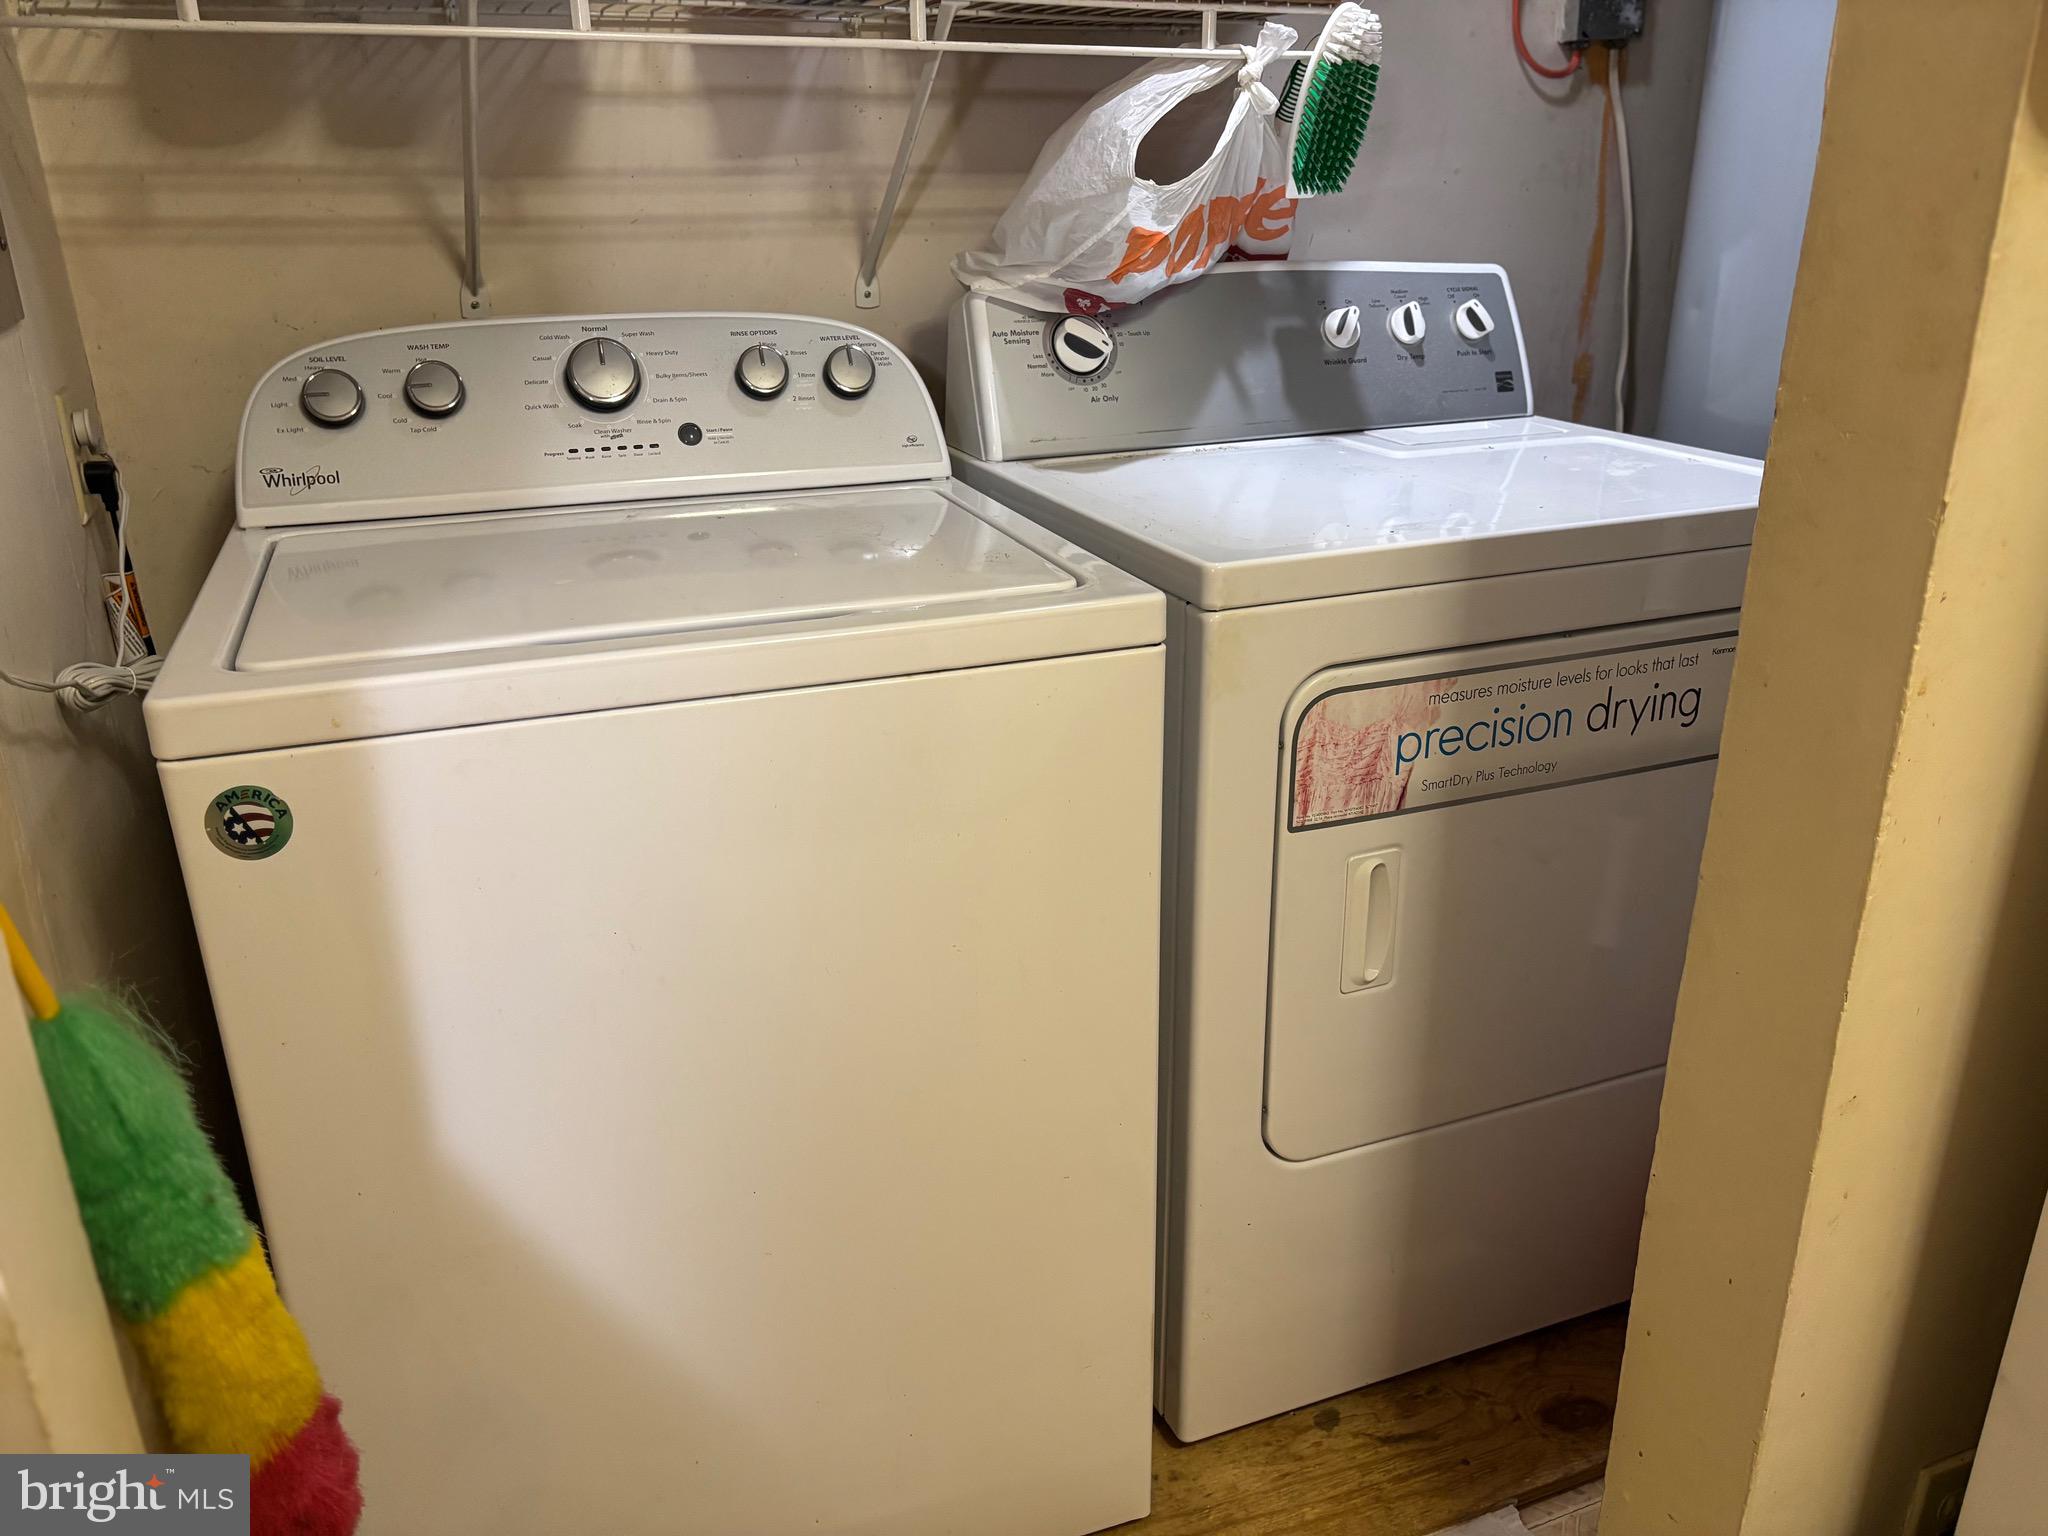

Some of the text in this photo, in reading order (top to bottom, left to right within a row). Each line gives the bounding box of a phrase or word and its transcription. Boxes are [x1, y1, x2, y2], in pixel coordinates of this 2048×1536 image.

[1004, 337, 1031, 345] Sensing
[1010, 328, 1040, 337] Moisture
[1410, 353, 1425, 361] Temp
[1102, 395, 1119, 403] Only
[261, 469, 340, 490] Whirlpool
[1428, 652, 1700, 706] measures moisture levels for looks that last
[1394, 682, 1702, 776] precision drying
[1421, 759, 1558, 792] SmartDry Plus Technology
[215, 788, 288, 820] AMERICA
